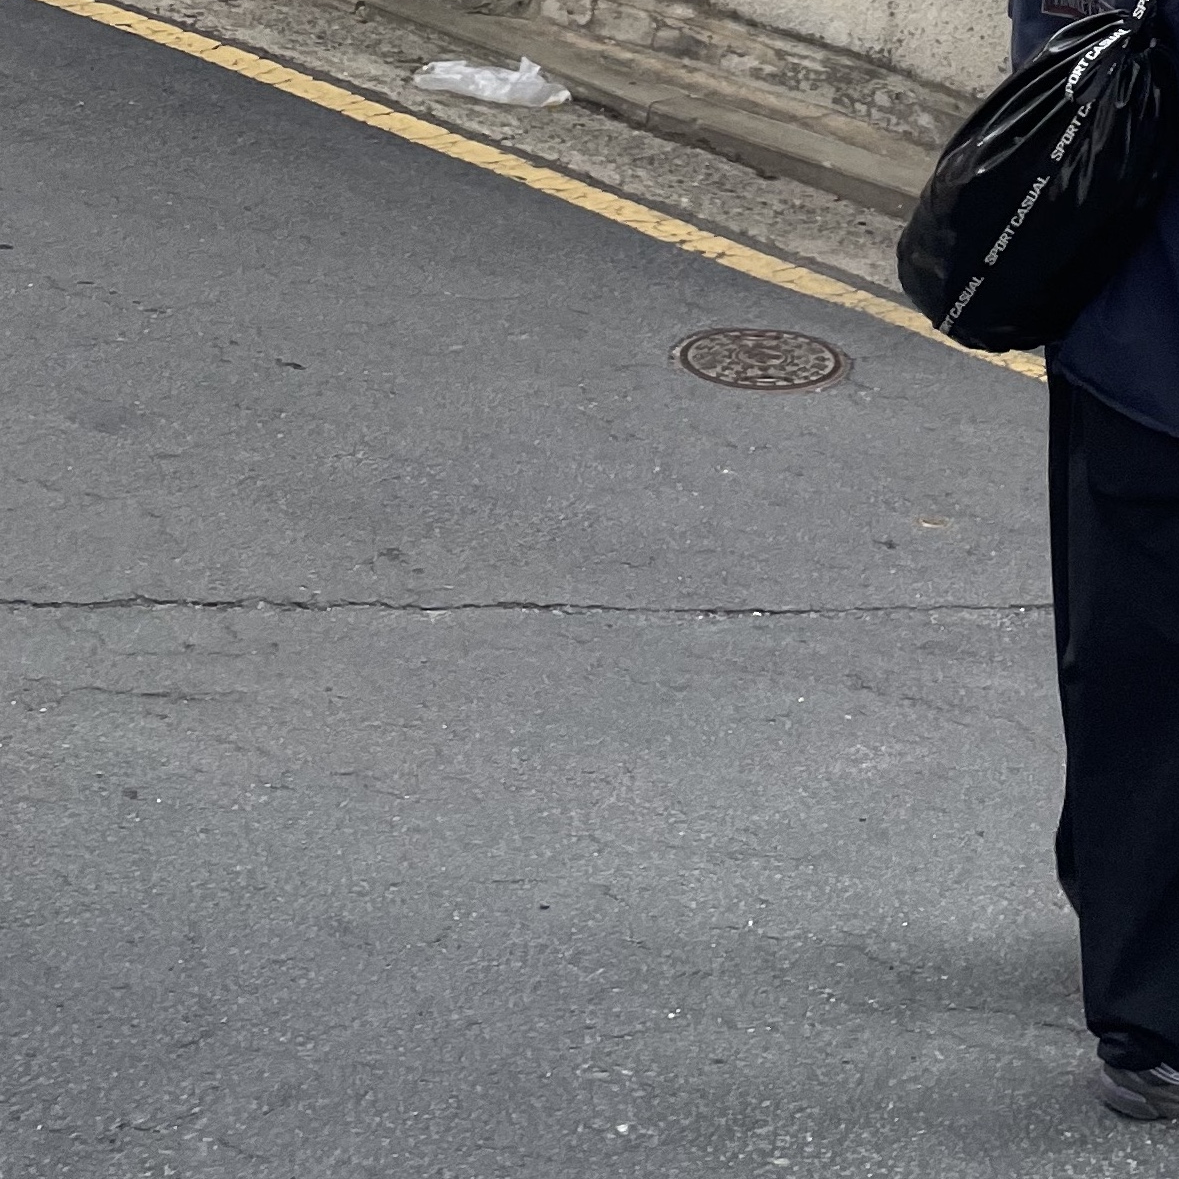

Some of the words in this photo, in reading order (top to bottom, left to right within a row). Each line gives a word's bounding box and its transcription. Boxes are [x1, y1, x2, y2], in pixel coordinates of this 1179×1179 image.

[1085, 27, 1132, 61] CASUAL
[1051, 116, 1082, 162] SPORT
[984, 224, 1016, 267] SPORT
[1010, 175, 1051, 228] CASUAL
[950, 275, 985, 320] CASUAL
